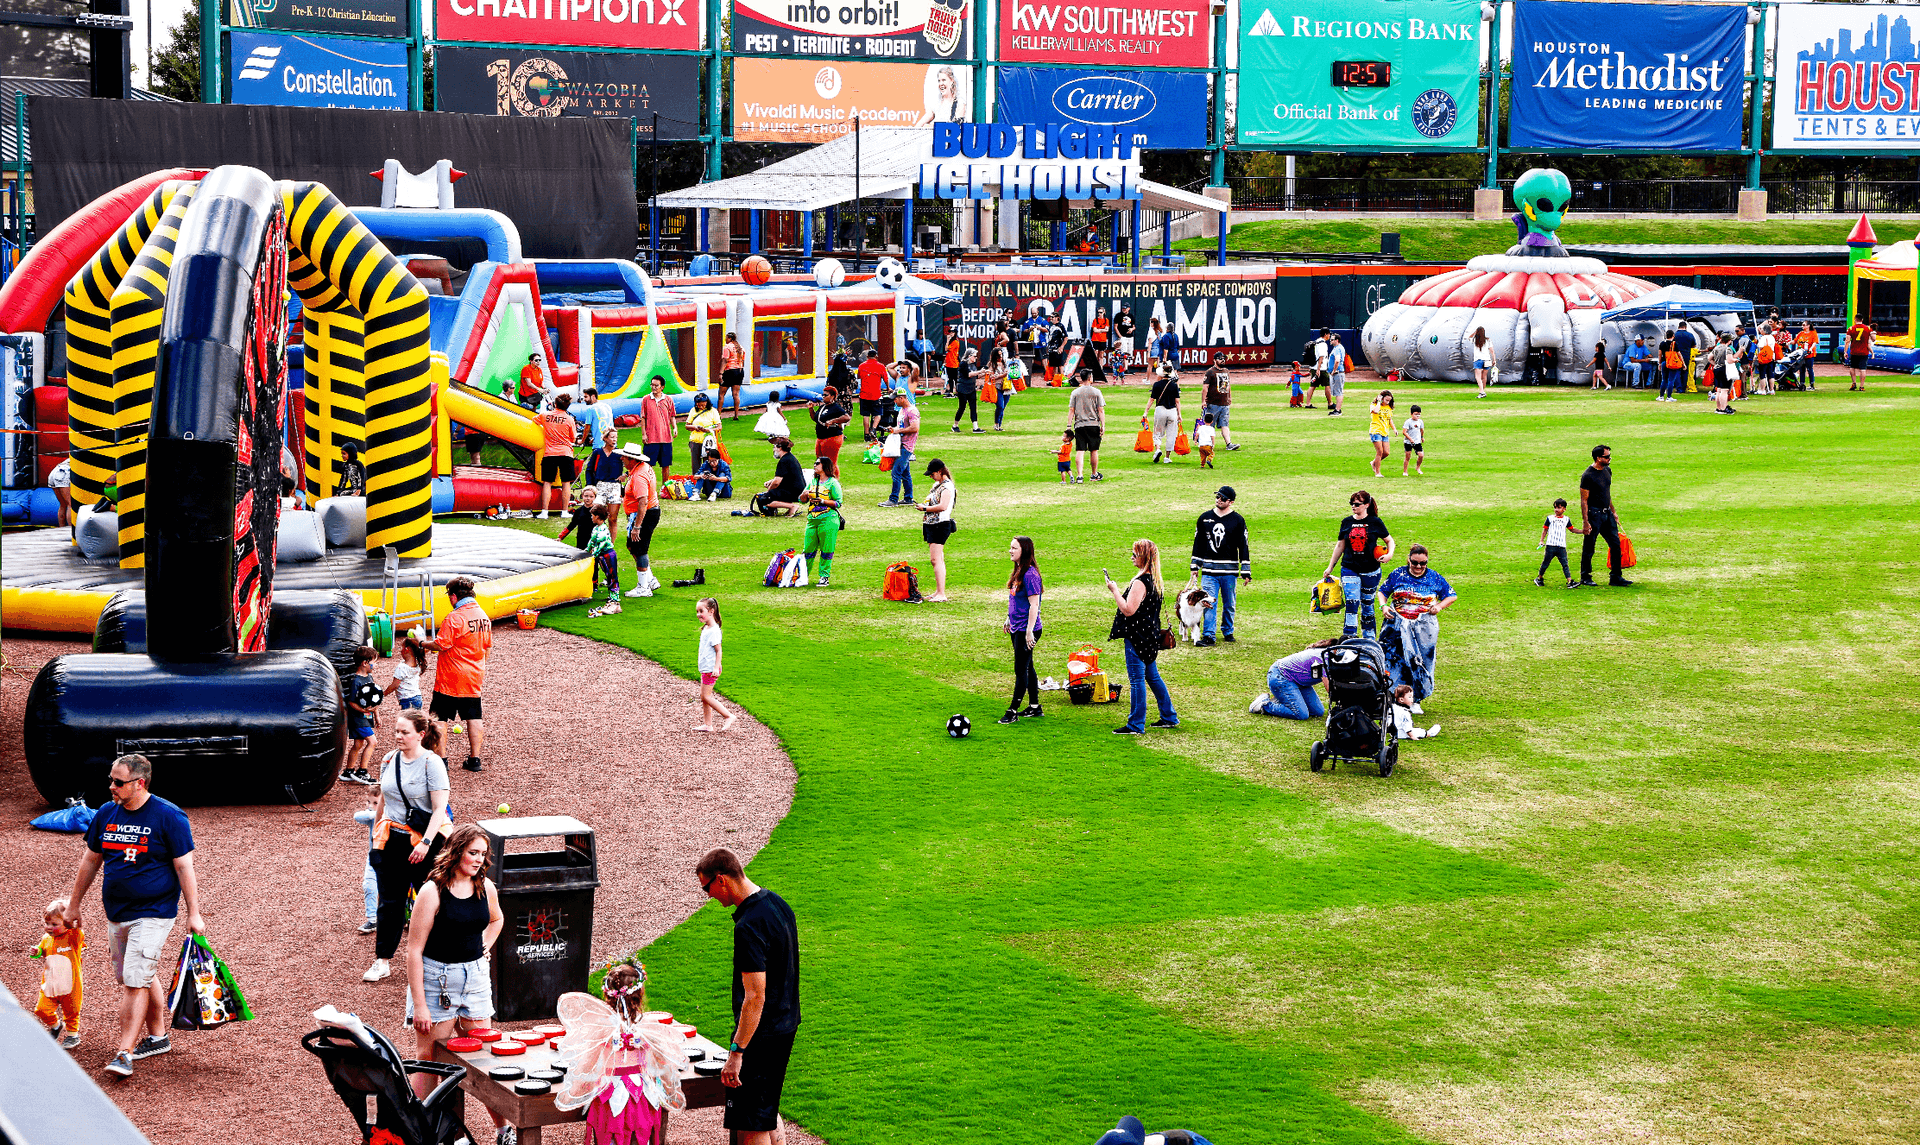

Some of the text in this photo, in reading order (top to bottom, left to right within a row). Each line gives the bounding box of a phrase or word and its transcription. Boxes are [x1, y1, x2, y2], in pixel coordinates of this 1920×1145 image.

[327, 7, 361, 20] Christian
[361, 11, 397, 23] Education
[787, 0, 899, 27] into orbit!
[930, 7, 957, 27] TRULY
[1064, 4, 1199, 38] SOUTHWEST
[926, 19, 954, 39] NOLEN
[1291, 15, 1474, 41] REGIONS BANK
[745, 33, 778, 52] PEST
[792, 35, 850, 55] TERMITE
[865, 37, 917, 57] RODENT
[1119, 38, 1163, 54] REALTY
[1533, 41, 1611, 55] HOUSTON
[1343, 63, 1391, 84] 12:51
[1532, 51, 1725, 92] Methodist
[565, 82, 650, 98] WAZOBIA
[569, 98, 650, 109] MARKET
[1067, 87, 1144, 111] Carrier
[1585, 97, 1723, 111] LEADING MEDICINE
[743, 102, 920, 125] Vivaldi Music Academy
[1273, 103, 1401, 121] Official Bank of
[741, 121, 755, 132] #1
[759, 121, 800, 133] MUSIC
[1797, 117, 1867, 136] TENTS
[1875, 117, 1888, 136] &
[932, 121, 1139, 159] BUD LIGHT
[918, 163, 1144, 200] ICE HOUSE
[952, 281, 1272, 298] OFFICIAL INJURY LAW FIRM FOR THE SPACE COWBOYS
[963, 307, 1004, 322] BEFOR
[1145, 296, 1278, 347] AMARO
[949, 324, 996, 339] TOMOR
[1855, 327, 1865, 341] 7
[545, 414, 567, 425] STAFF
[103, 832, 139, 843] SERIES
[117, 824, 152, 835] WORLD
[124, 848, 138, 862] H
[516, 943, 567, 954] REPUBLIC
